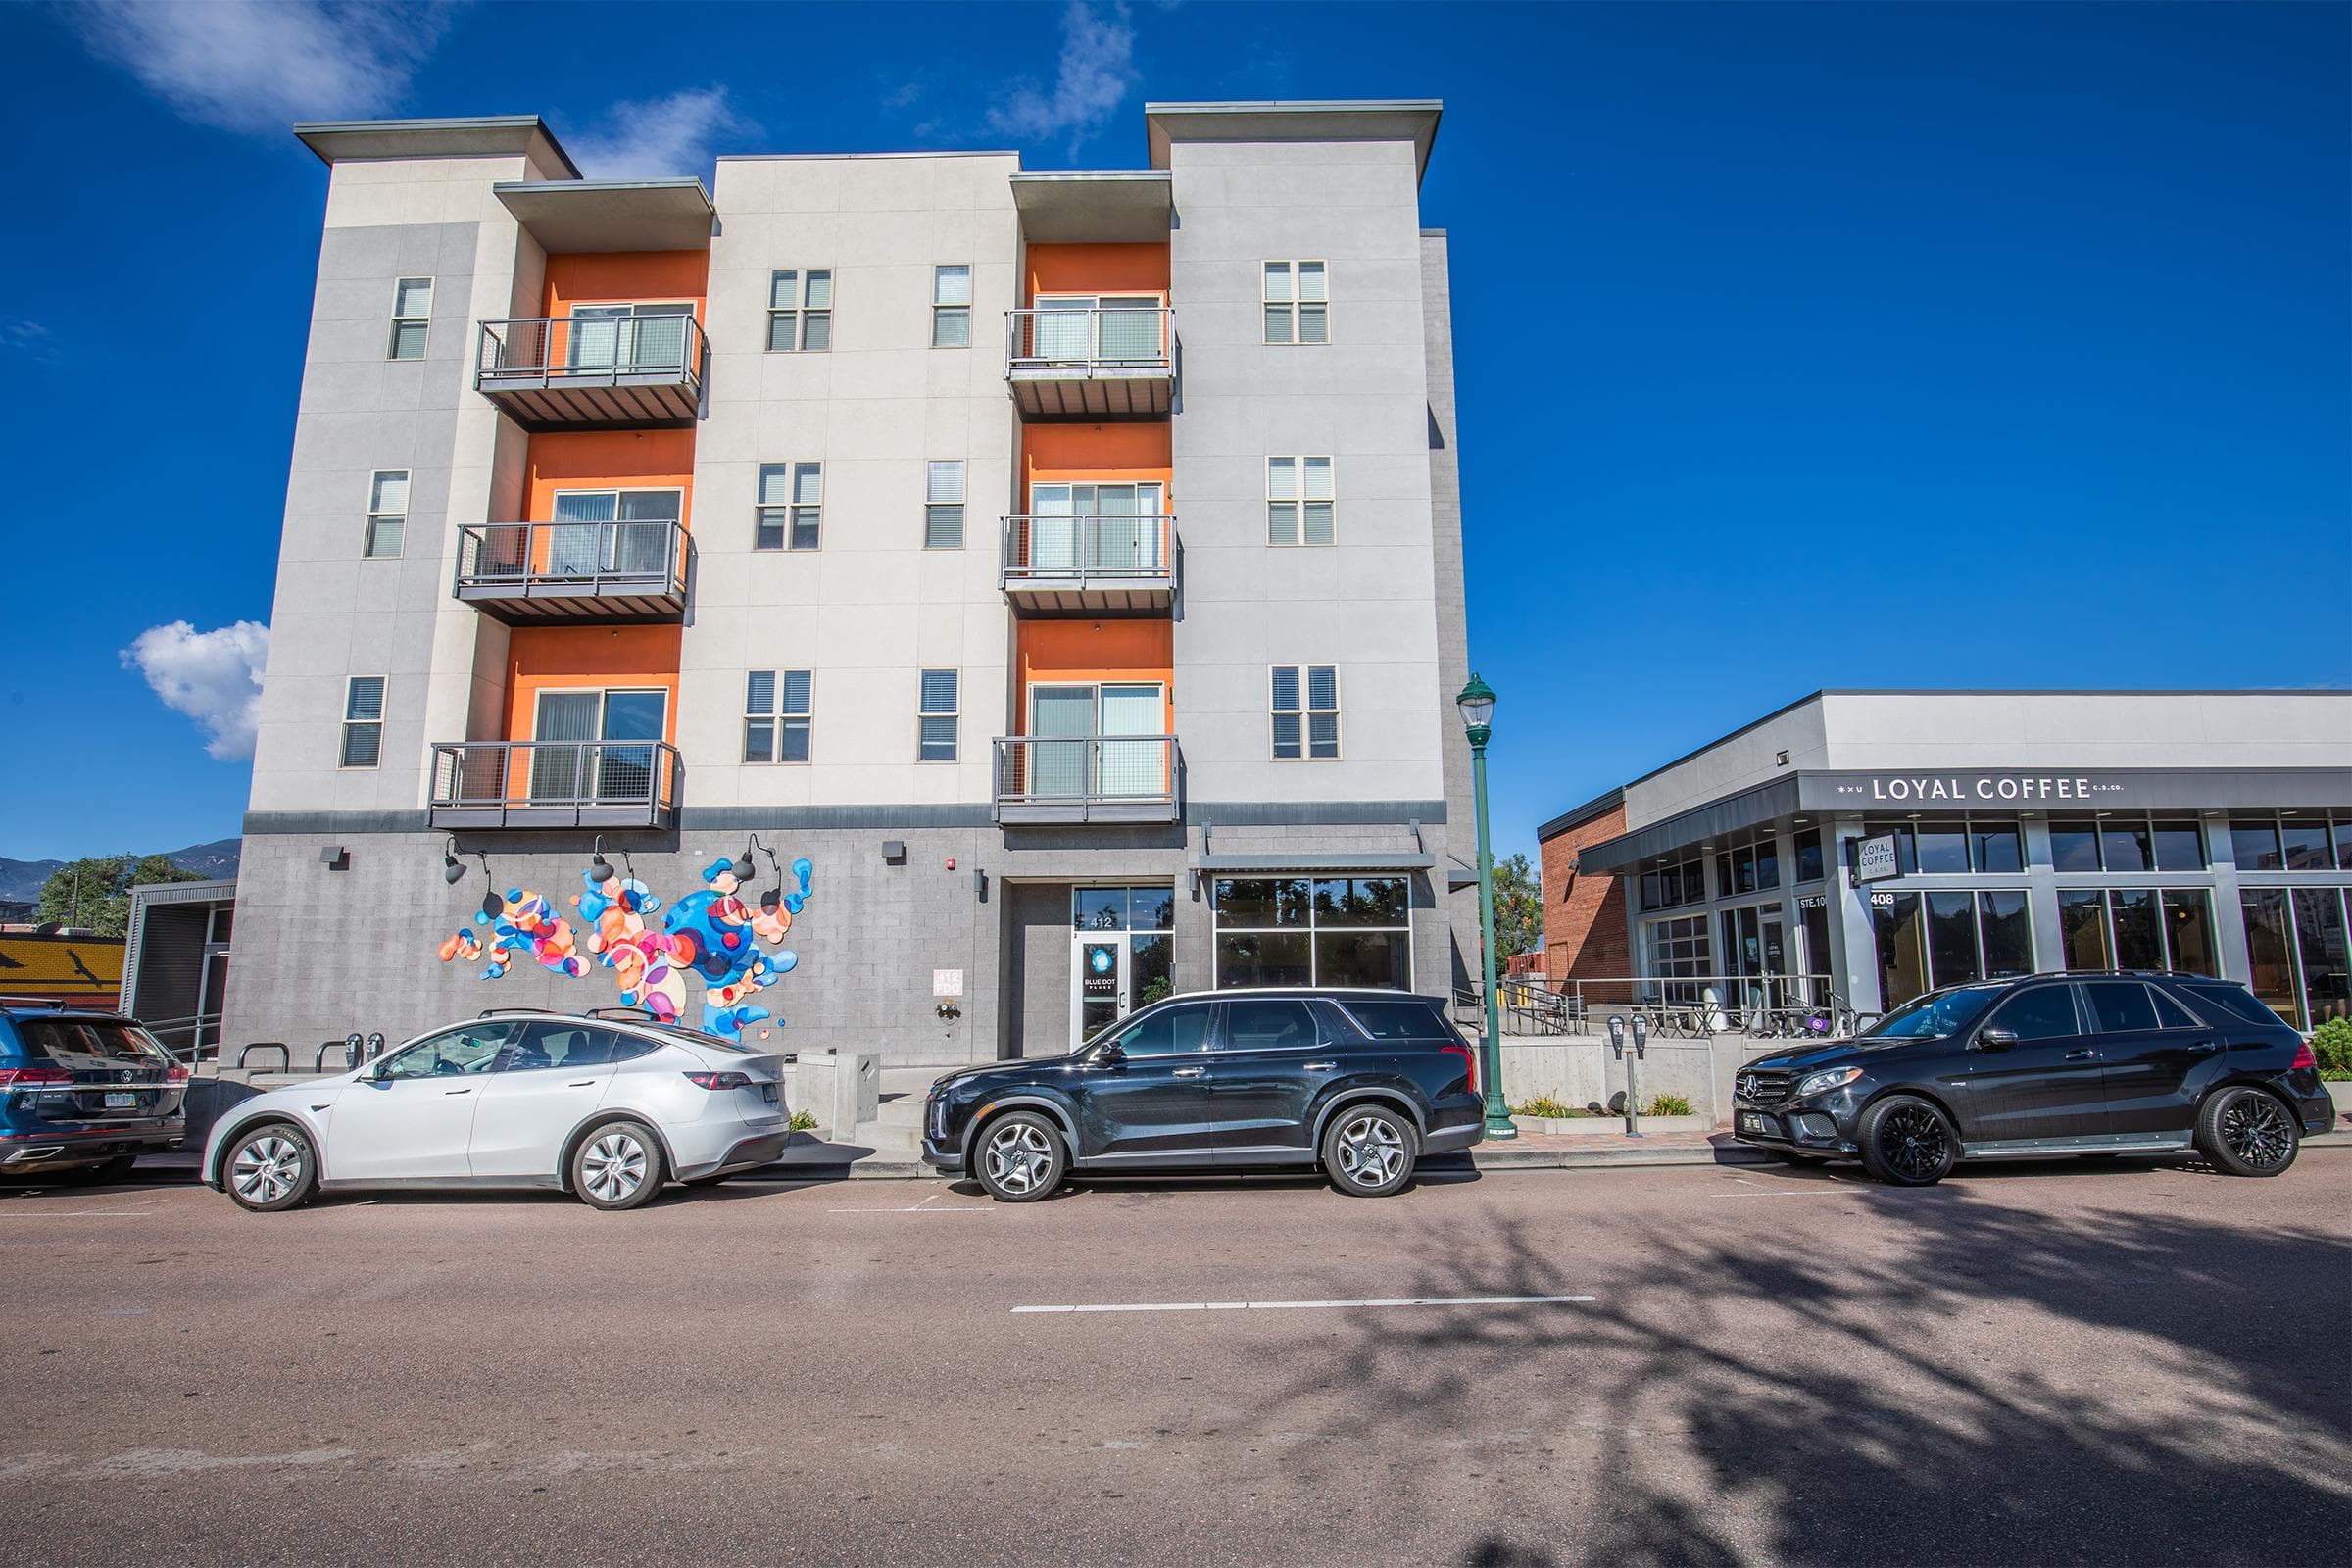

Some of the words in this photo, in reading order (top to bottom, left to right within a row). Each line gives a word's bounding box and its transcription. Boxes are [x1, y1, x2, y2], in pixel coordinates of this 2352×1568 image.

[1873, 779, 1966, 800] LOYAL
[1976, 778, 2090, 799] COFFEE
[1863, 843, 1890, 856] LOYAL
[1862, 853, 1895, 866] COFFEE
[1800, 896, 1827, 909] STE.10
[1871, 894, 1894, 905] 408
[1090, 917, 1112, 928] 412
